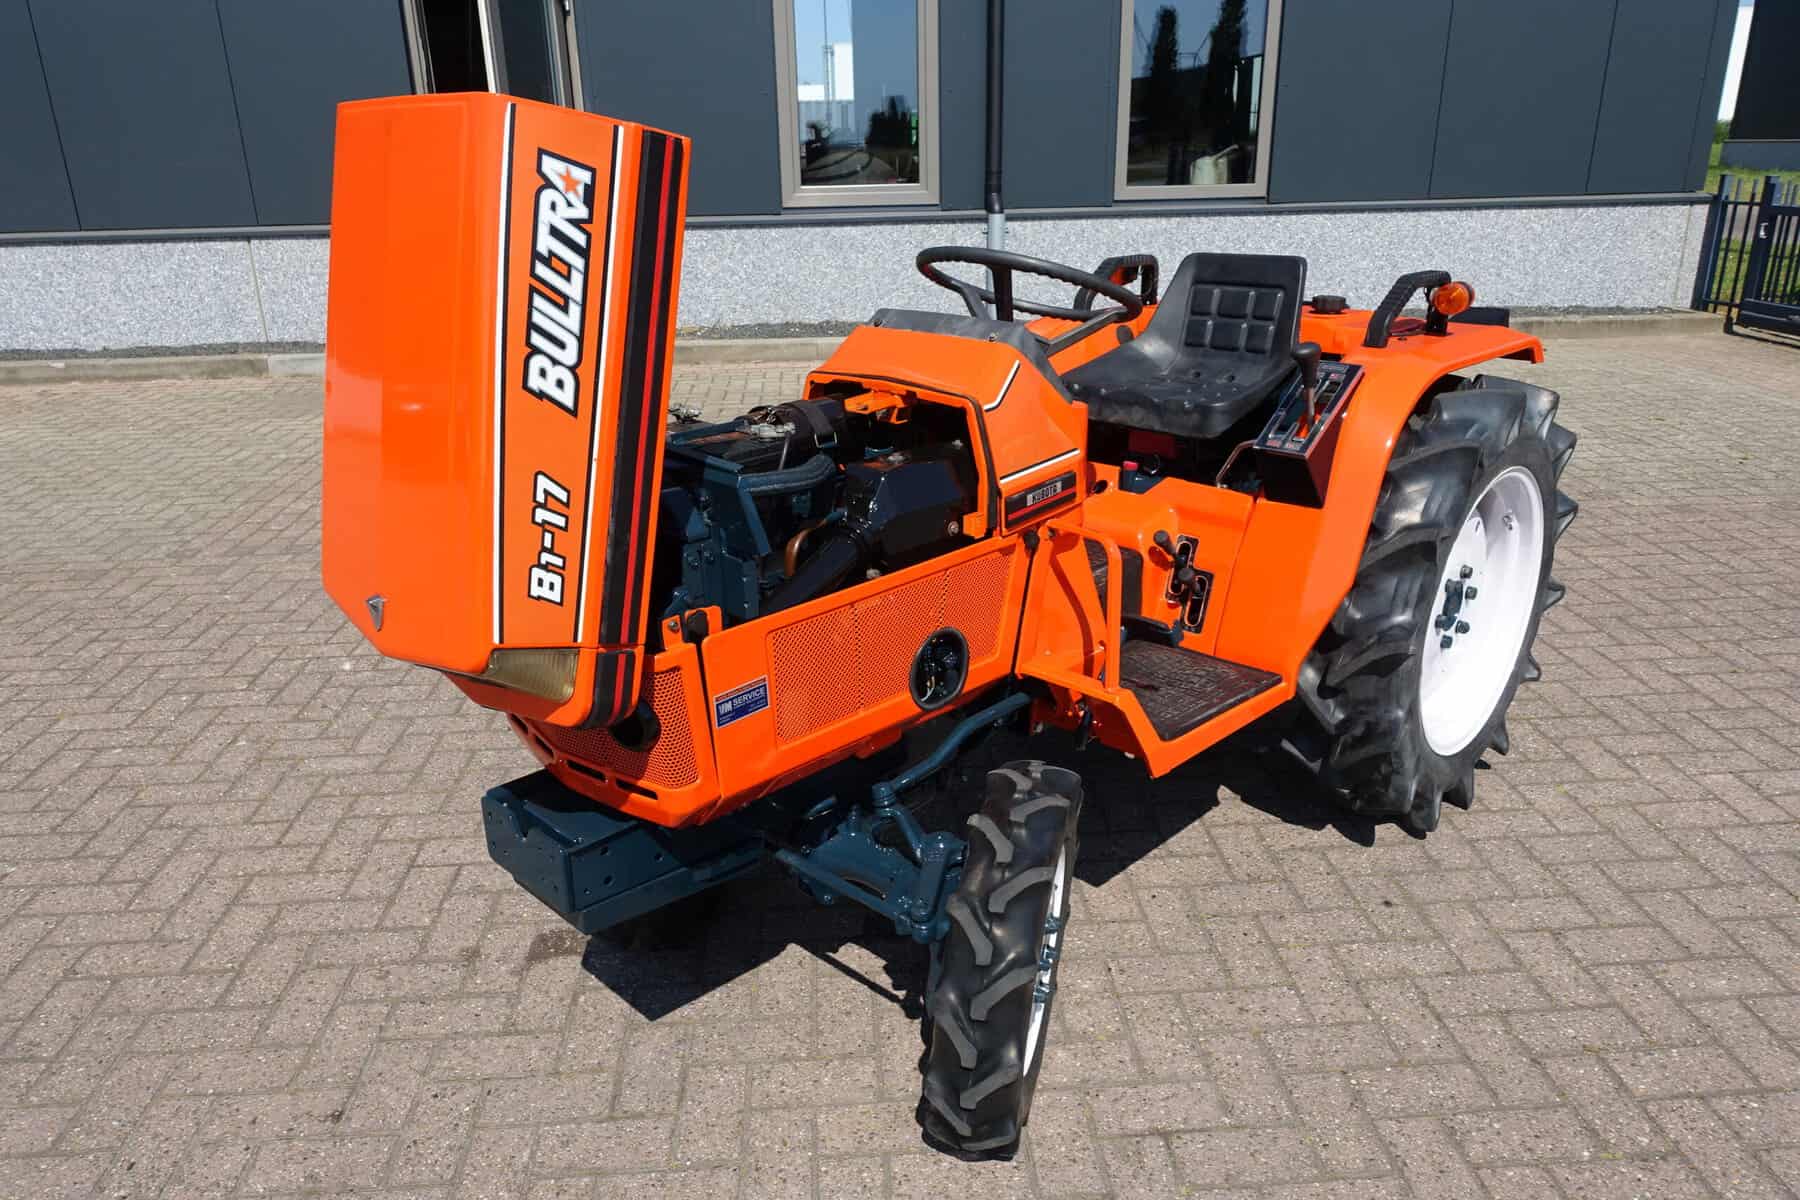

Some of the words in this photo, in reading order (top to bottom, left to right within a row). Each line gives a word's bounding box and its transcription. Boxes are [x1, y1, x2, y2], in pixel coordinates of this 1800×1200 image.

[523, 148, 596, 418] BULLTRA
[528, 470, 570, 606] B1-17
[733, 686, 766, 707] SERVICE
